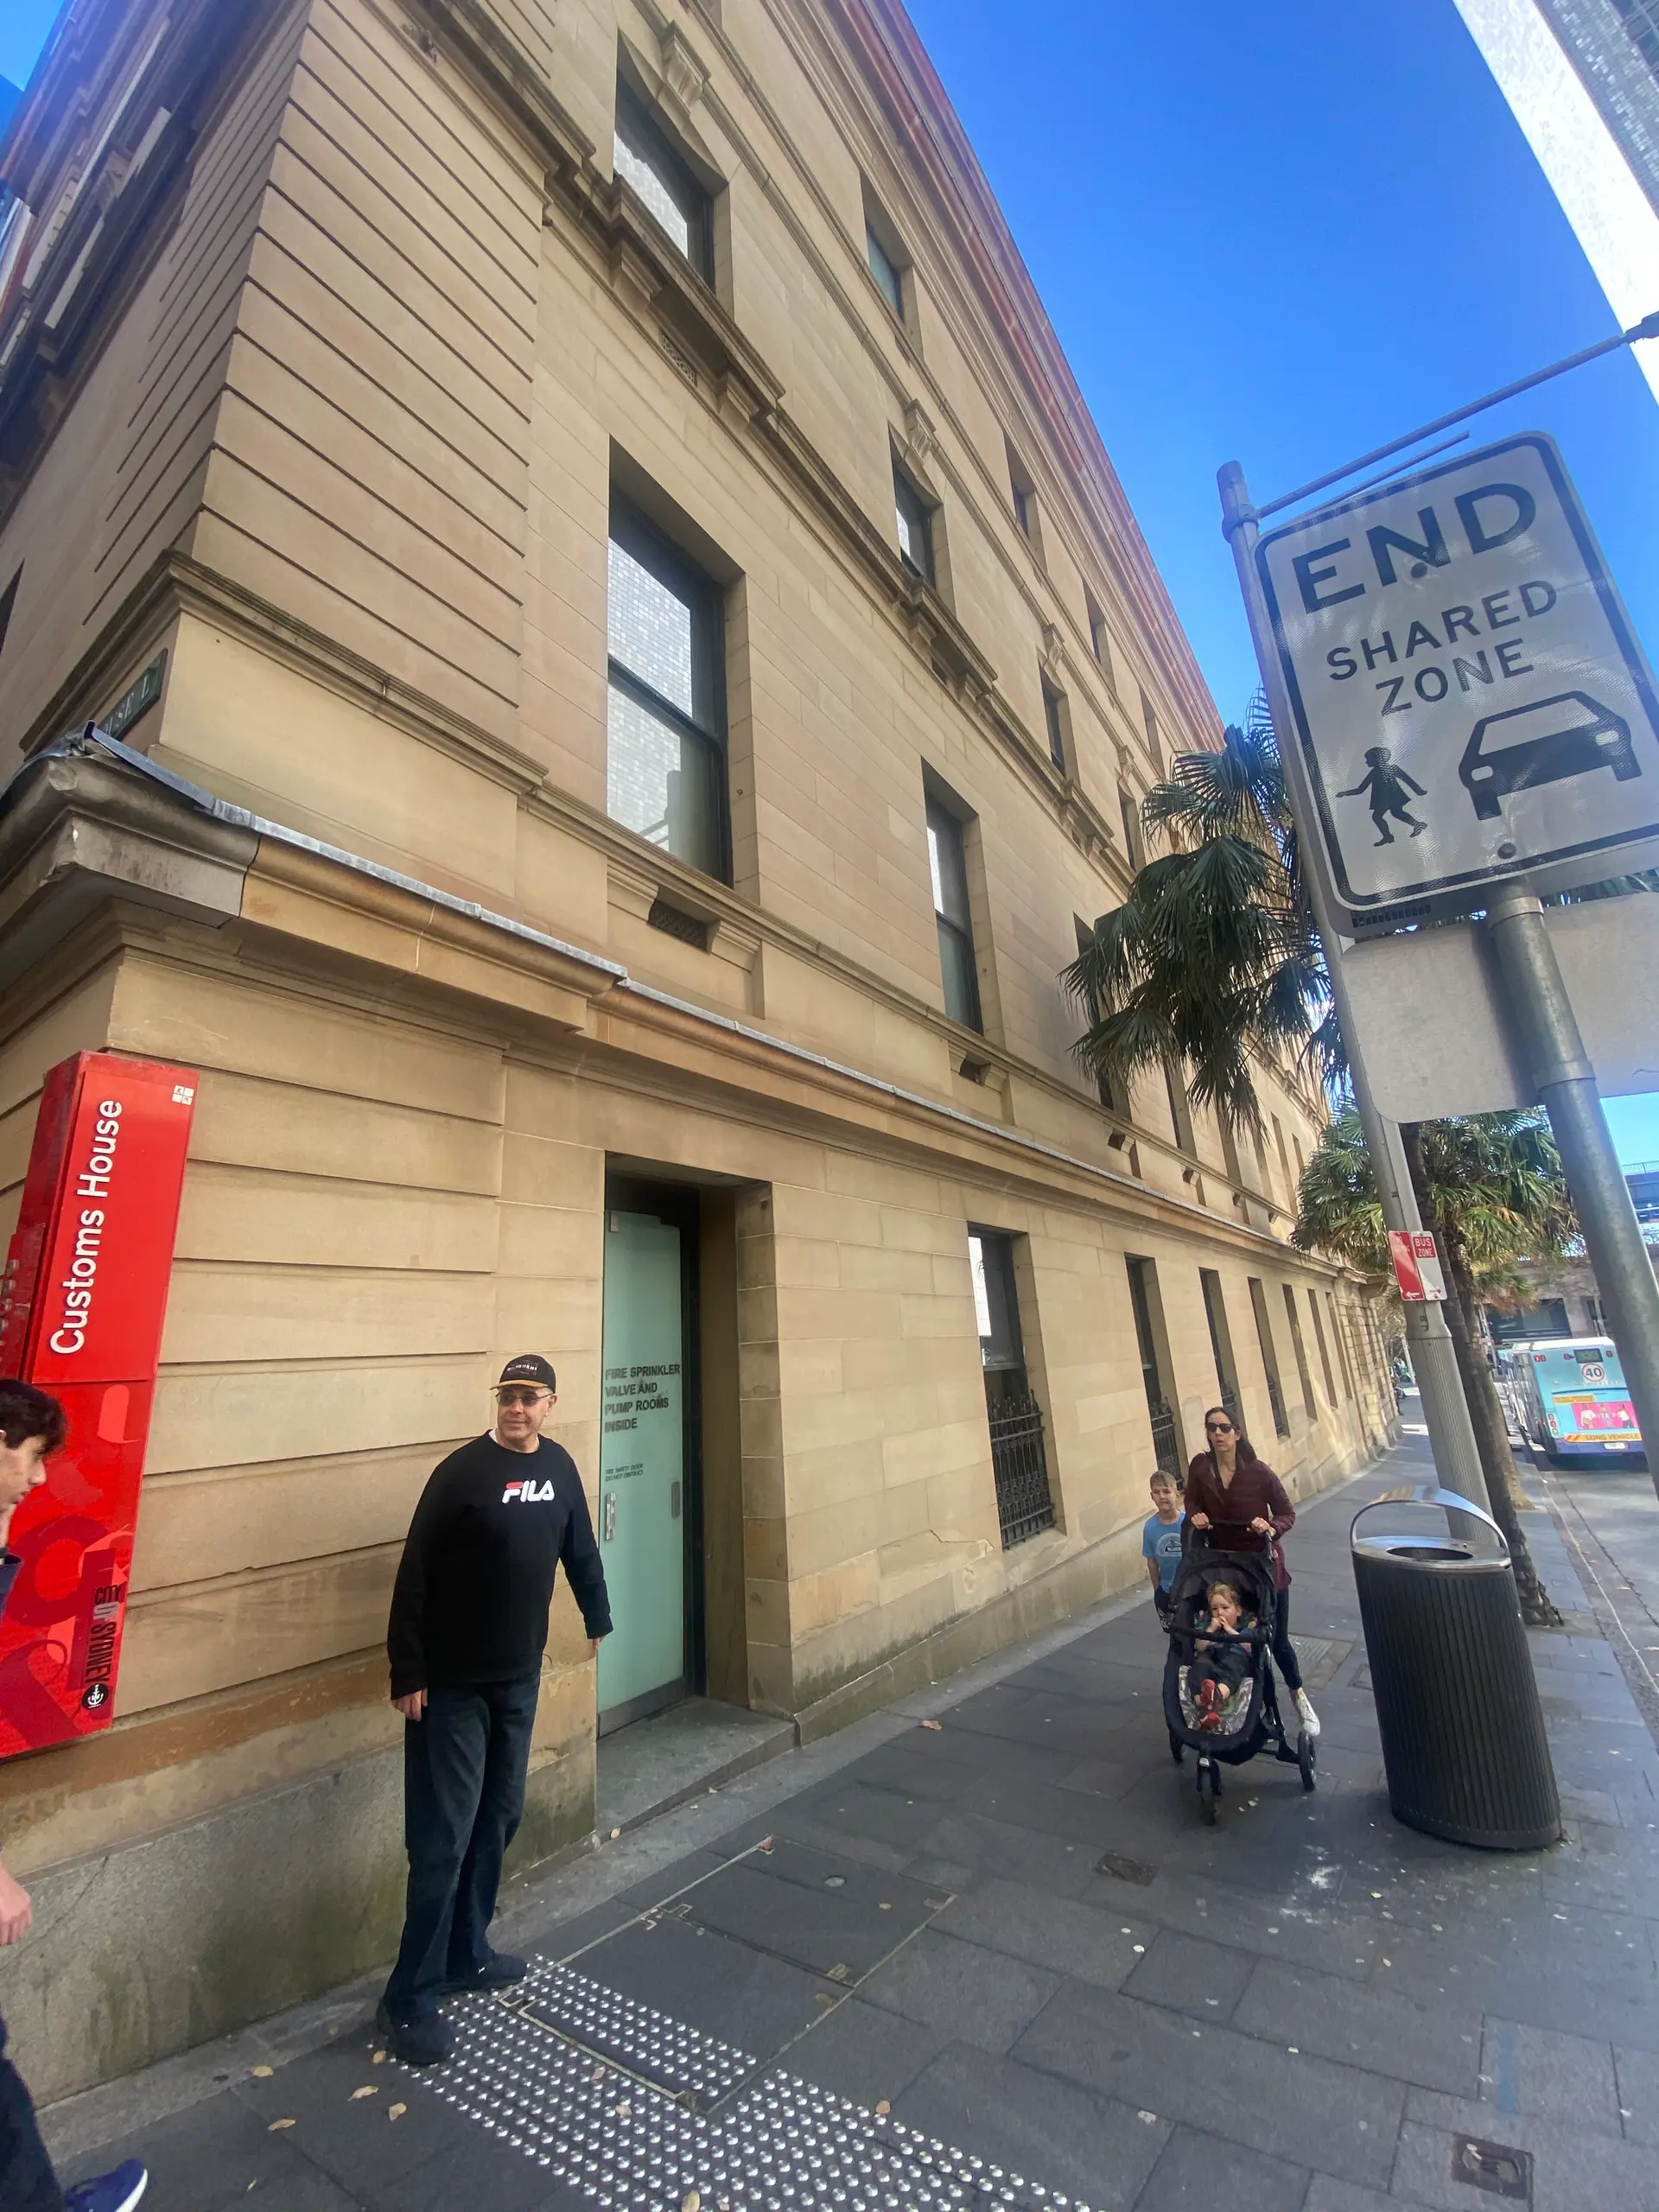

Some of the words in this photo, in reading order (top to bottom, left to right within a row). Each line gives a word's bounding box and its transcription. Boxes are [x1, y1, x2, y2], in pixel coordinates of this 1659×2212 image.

[1293, 483, 1536, 613] END
[1326, 580, 1558, 681] SHARED
[1376, 638, 1535, 716] ZONE
[77, 1100, 123, 1198] House
[1414, 1237, 1432, 1247] BUS
[1418, 1248, 1433, 1257] ZONE
[50, 1210, 105, 1354] Customs
[606, 1368, 627, 1380] FIRE
[630, 1363, 681, 1378] SPRINKLER
[1586, 1368, 1602, 1377] 40
[605, 1384, 636, 1397] VALVE
[638, 1382, 658, 1394] AND
[605, 1402, 632, 1415] PUMP
[636, 1397, 669, 1411] ROOMS
[605, 1418, 638, 1433] INSIDE
[501, 1479, 555, 1503] FILA
[94, 1584, 123, 1605] CITY
[93, 1602, 119, 1622] OF
[85, 1622, 117, 1683] SYDNEY
